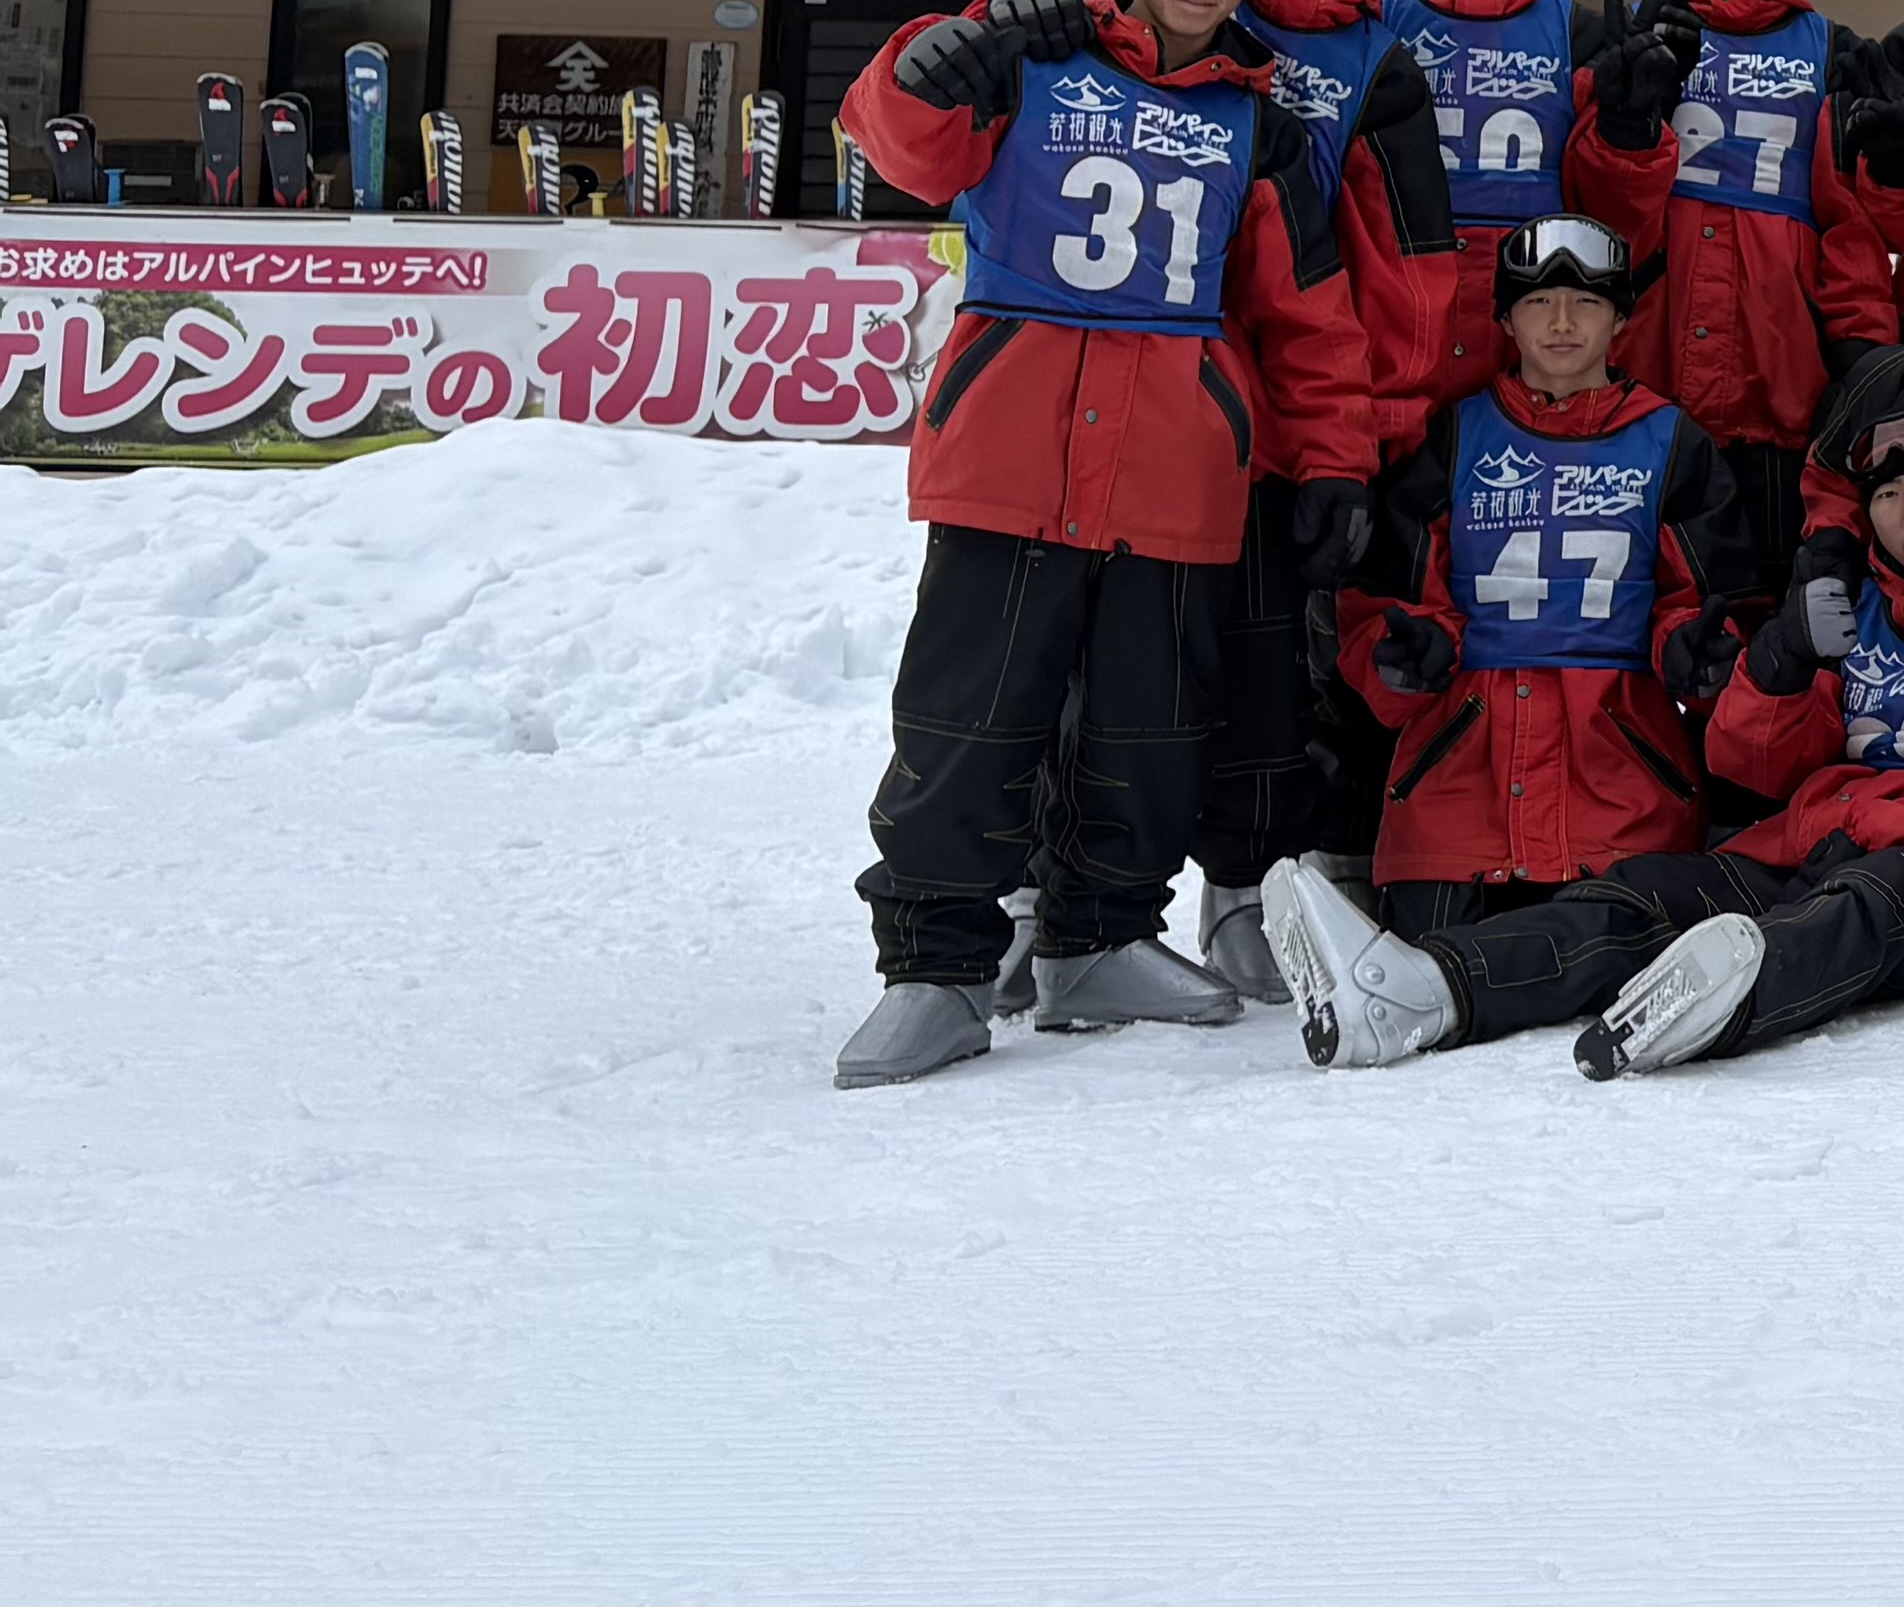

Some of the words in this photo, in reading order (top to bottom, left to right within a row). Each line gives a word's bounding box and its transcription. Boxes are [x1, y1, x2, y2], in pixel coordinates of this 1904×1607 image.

[1671, 101, 1797, 194] 27
[1053, 156, 1204, 305] 31
[1475, 531, 1631, 620] 47
